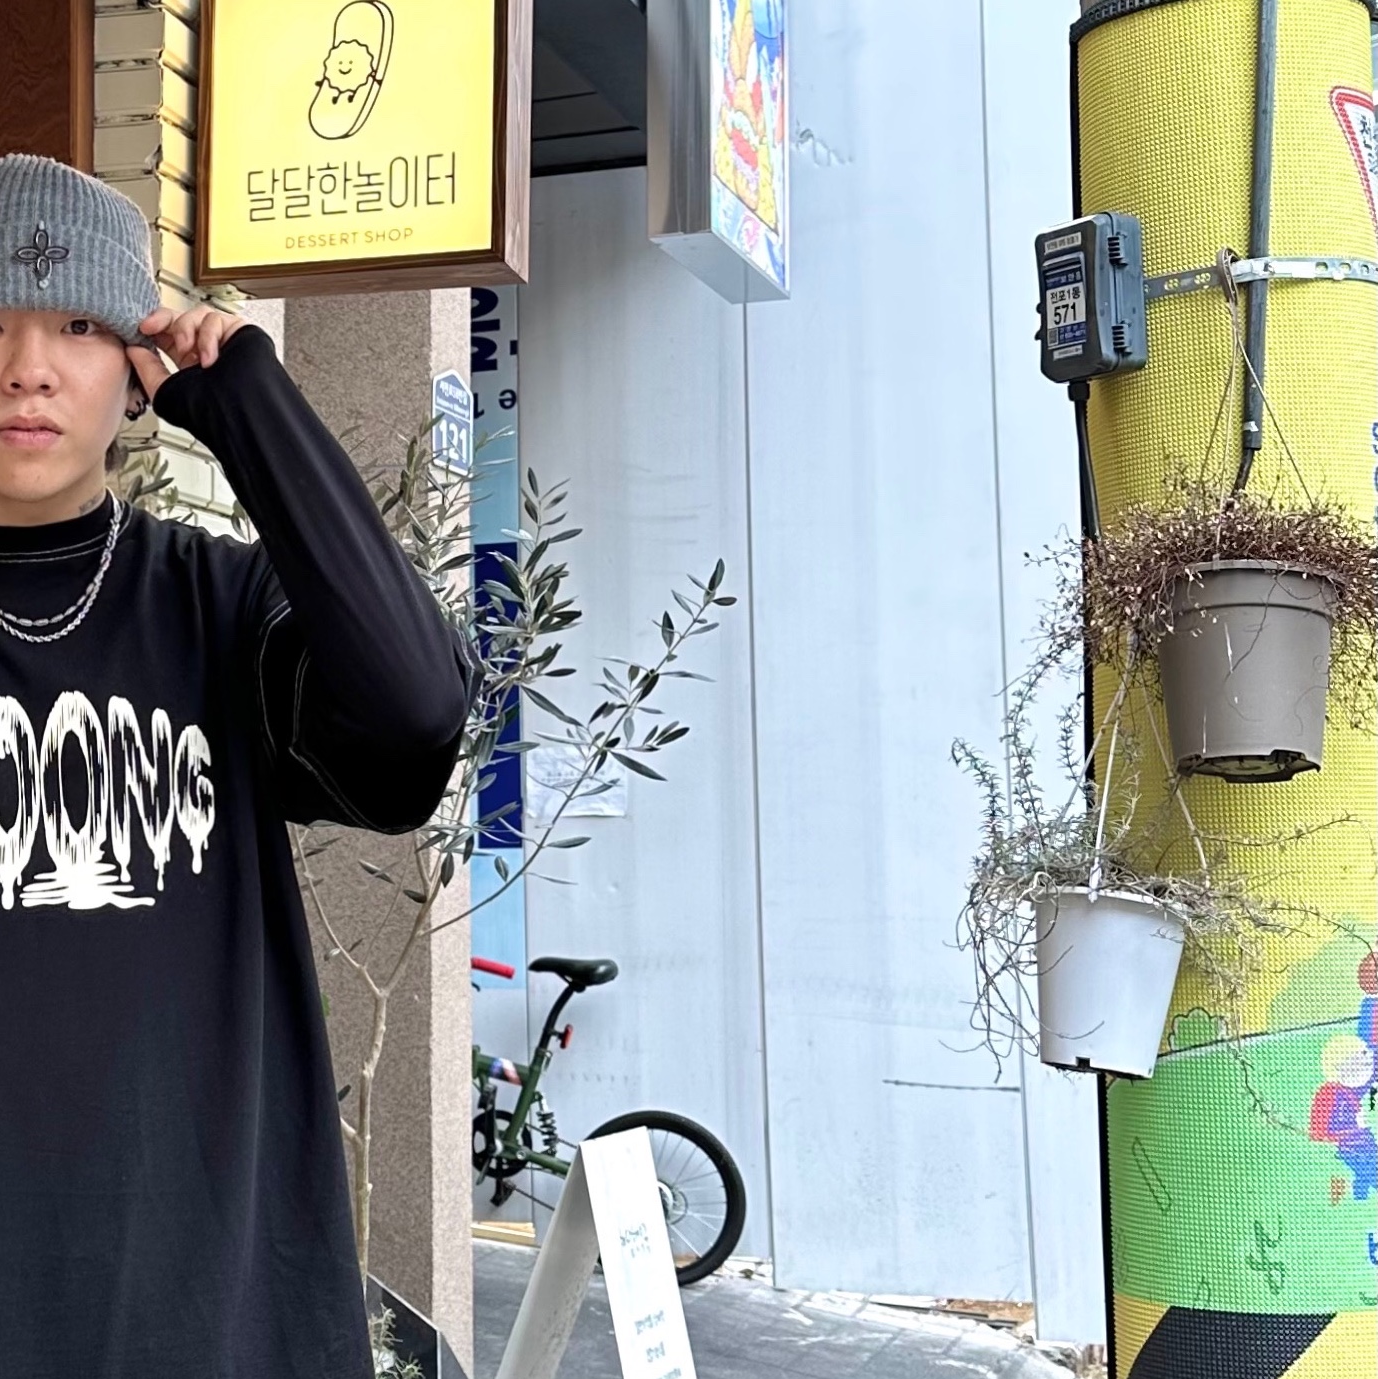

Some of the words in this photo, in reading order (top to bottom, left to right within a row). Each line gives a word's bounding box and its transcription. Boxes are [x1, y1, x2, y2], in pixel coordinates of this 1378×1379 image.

[247, 151, 456, 222] 달달한놀이터
[285, 232, 359, 249] DESSERT
[364, 227, 414, 243] SHOP
[1053, 302, 1077, 325] 571
[439, 419, 467, 464] 121
